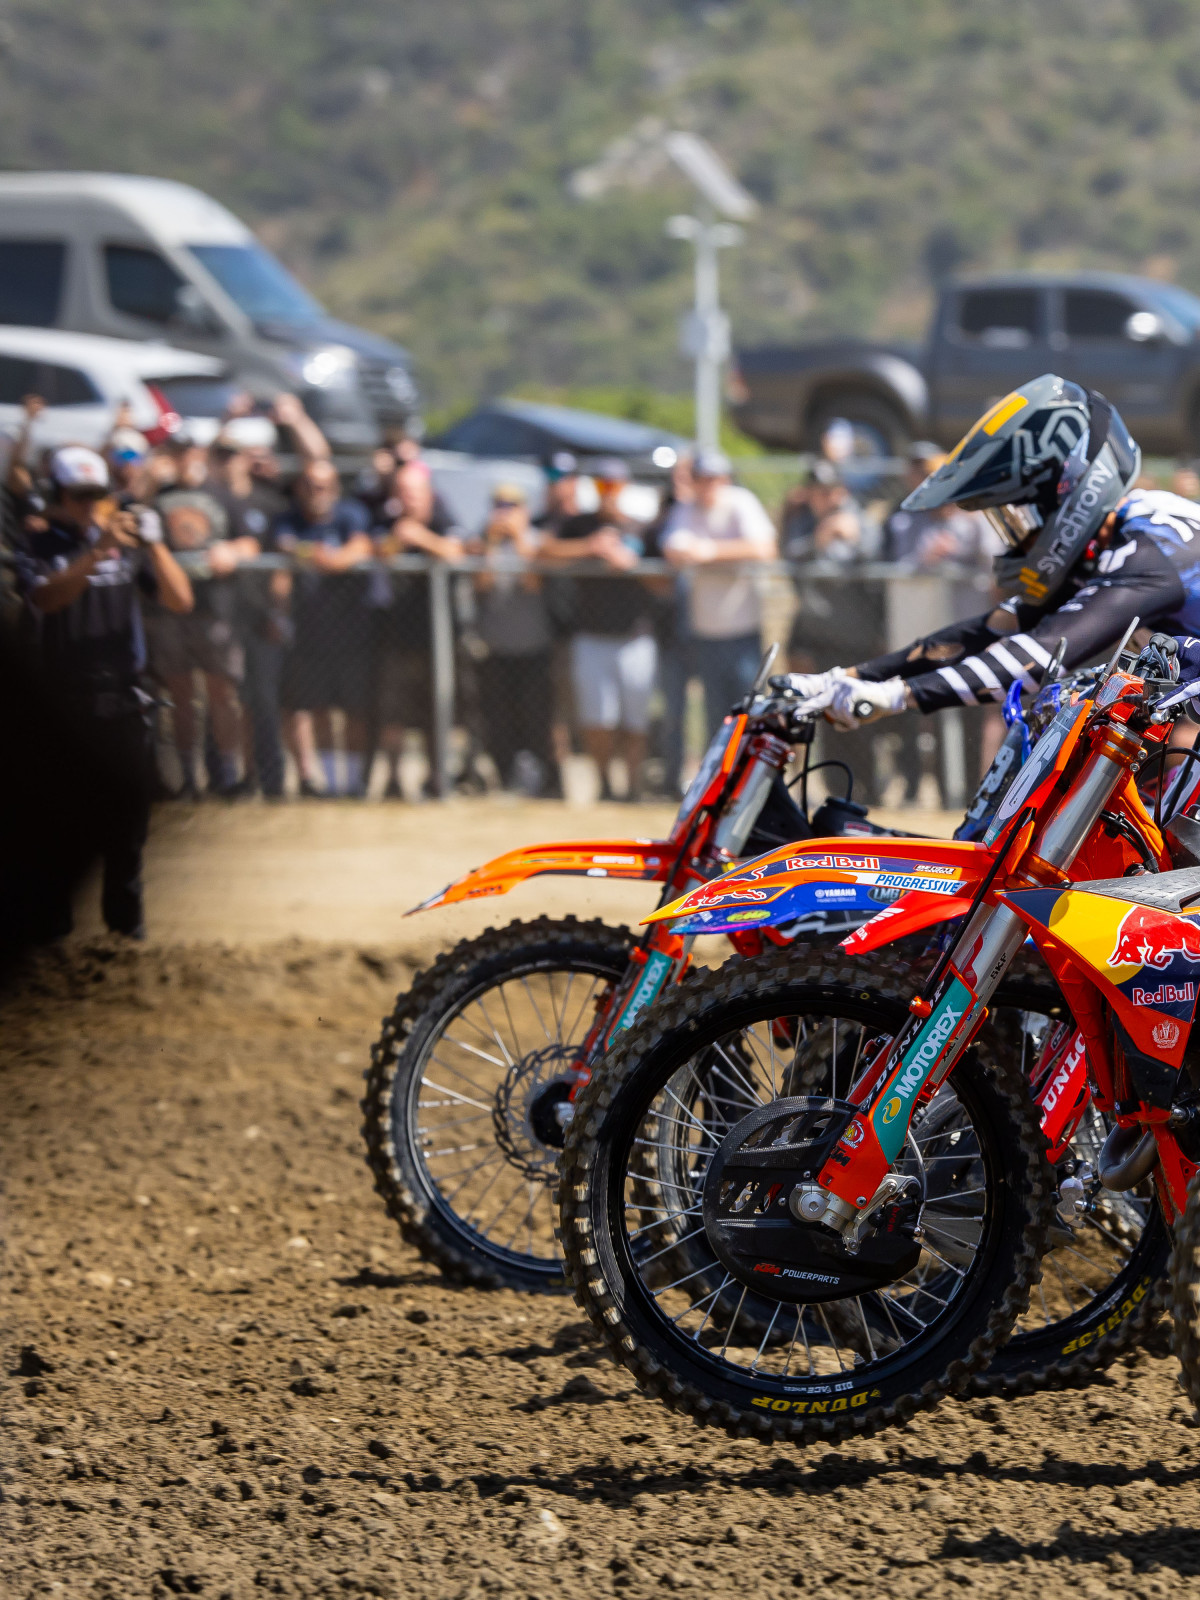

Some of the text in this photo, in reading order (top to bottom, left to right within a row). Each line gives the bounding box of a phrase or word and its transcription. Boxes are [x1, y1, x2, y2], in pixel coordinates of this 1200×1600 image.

[1037, 458, 1114, 575] synchrony
[786, 856, 880, 870] Red Bull
[824, 888, 857, 898] YAMAHA
[875, 873, 962, 893] PROGRESSIVE
[990, 952, 1007, 980] SKF
[1132, 981, 1195, 1006] Red Bull
[876, 980, 945, 1091] DUNLP
[894, 1004, 963, 1099] MOTOREX
[1039, 1032, 1086, 1130] UNLO
[887, 1206, 901, 1232] brem
[753, 1262, 840, 1285] KTM POWERPARTS
[751, 1390, 870, 1414] DUNLOP
